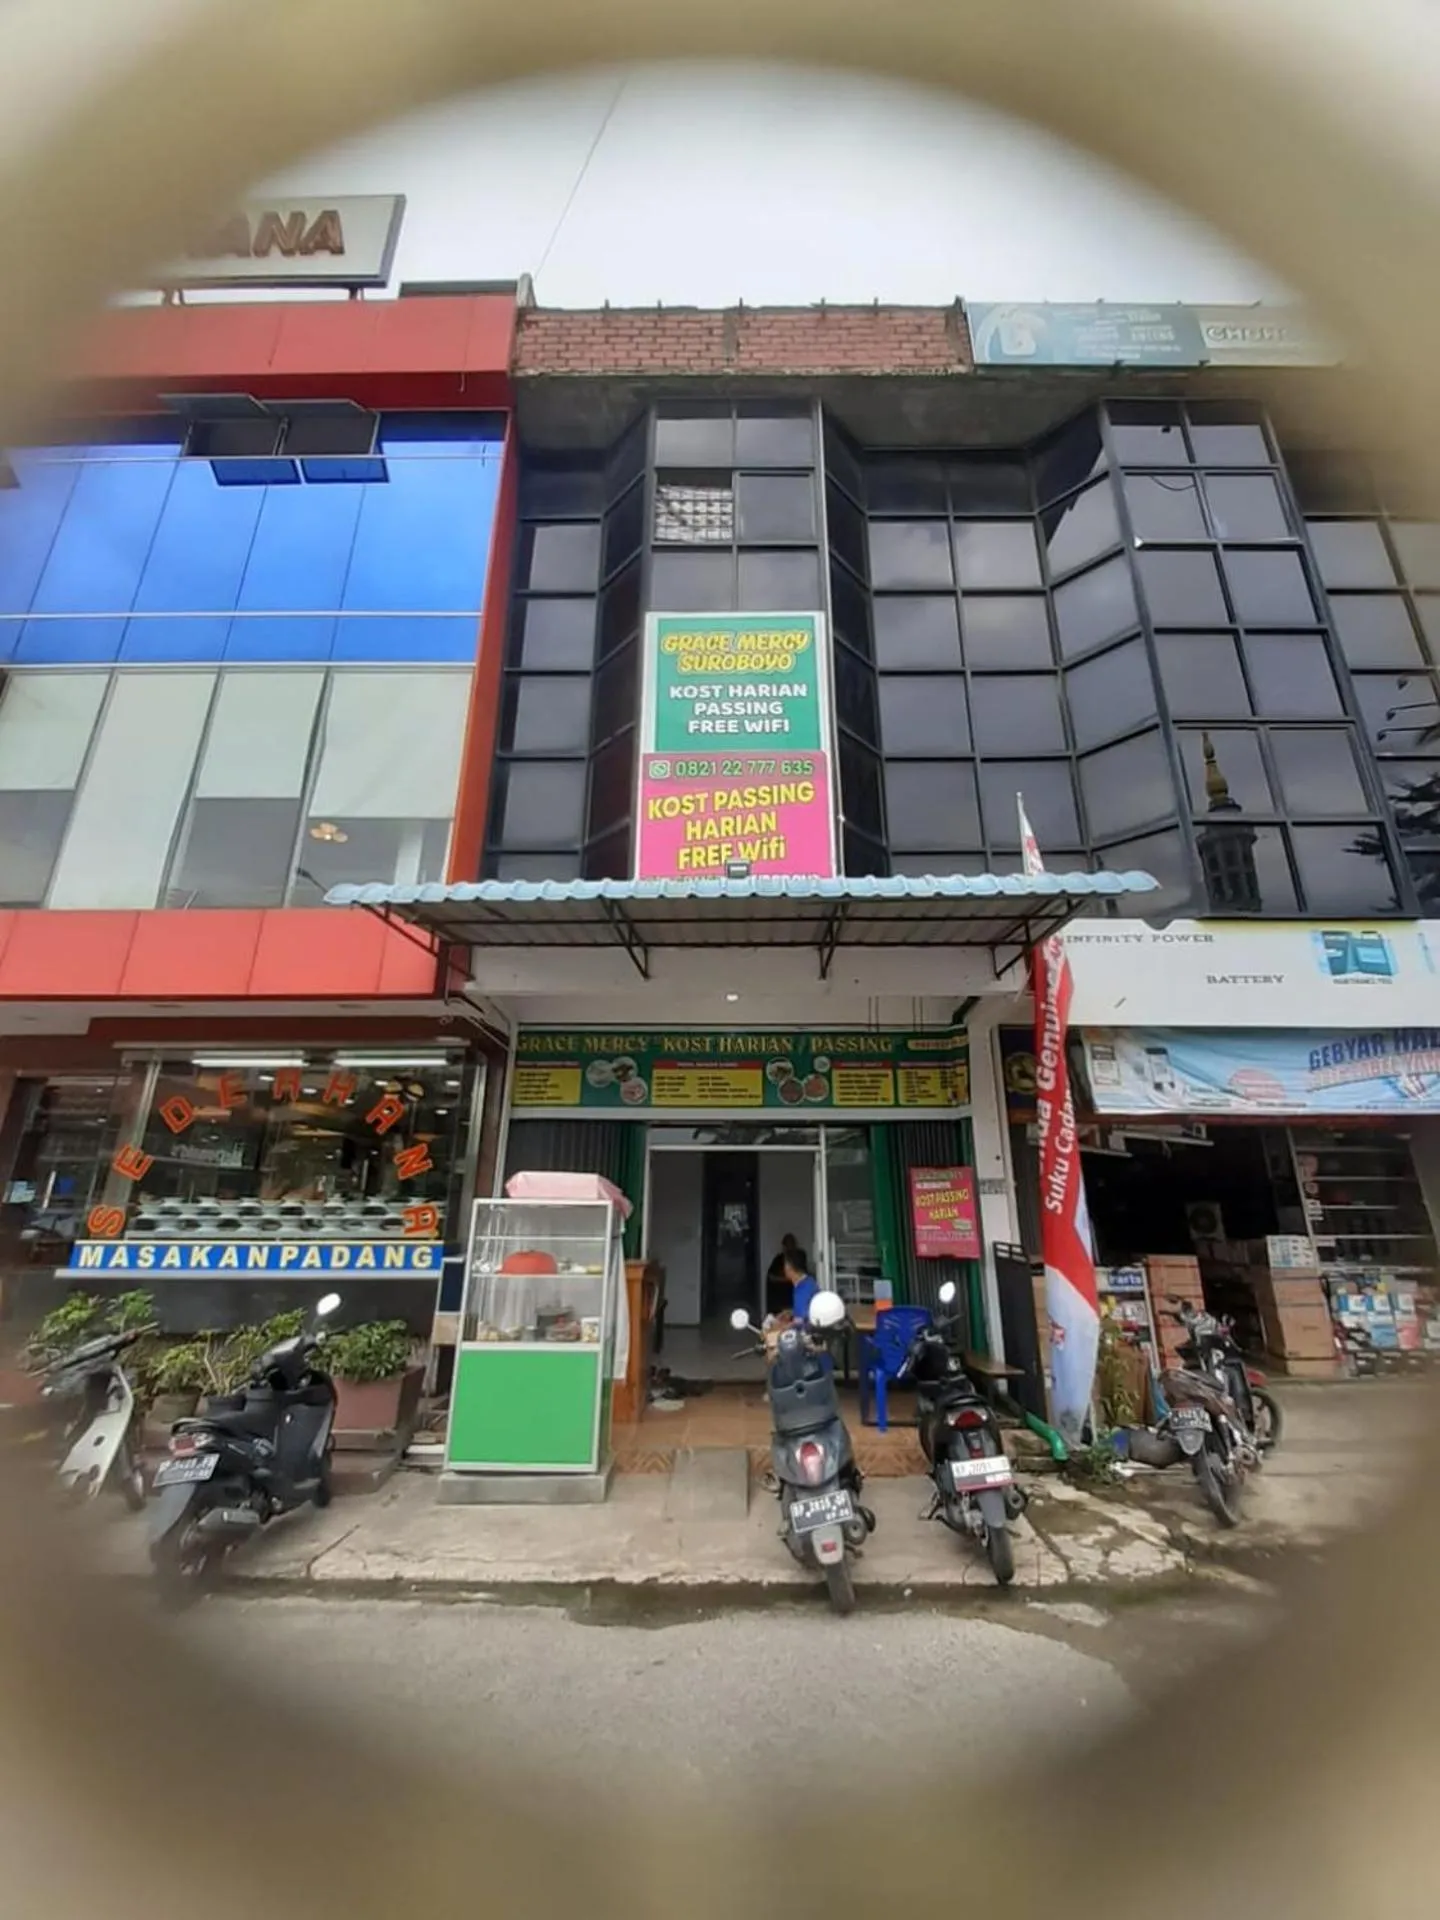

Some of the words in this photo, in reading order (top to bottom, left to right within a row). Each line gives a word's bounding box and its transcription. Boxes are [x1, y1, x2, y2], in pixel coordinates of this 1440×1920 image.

[663, 633, 730, 651] GRACE
[736, 631, 809, 651] MERCY
[677, 653, 794, 672] SUROBOYO
[669, 685, 722, 698] KOST
[728, 683, 807, 697] HARIAN
[694, 702, 783, 715] PASSING
[688, 720, 739, 732] FREE
[744, 719, 789, 732] WIFI
[675, 761, 717, 776] 0821
[722, 760, 743, 775] 22
[748, 760, 776, 775] 777
[781, 760, 813, 775] 635
[647, 793, 708, 820] KOST
[713, 781, 815, 812] PASSING
[686, 812, 777, 841] HARIAN
[678, 846, 733, 869] FREE
[738, 836, 786, 861] Wifi
[1066, 934, 1143, 943] INFINITY
[1152, 934, 1214, 943] POWER
[1206, 975, 1285, 985] BATTERY
[810, 1036, 893, 1052] PASSING
[1308, 1033, 1387, 1072] GEBYAR
[1046, 1159, 1072, 1214] Suku
[78, 1246, 272, 1268] MASAKAN
[279, 1246, 434, 1269] PADANG
